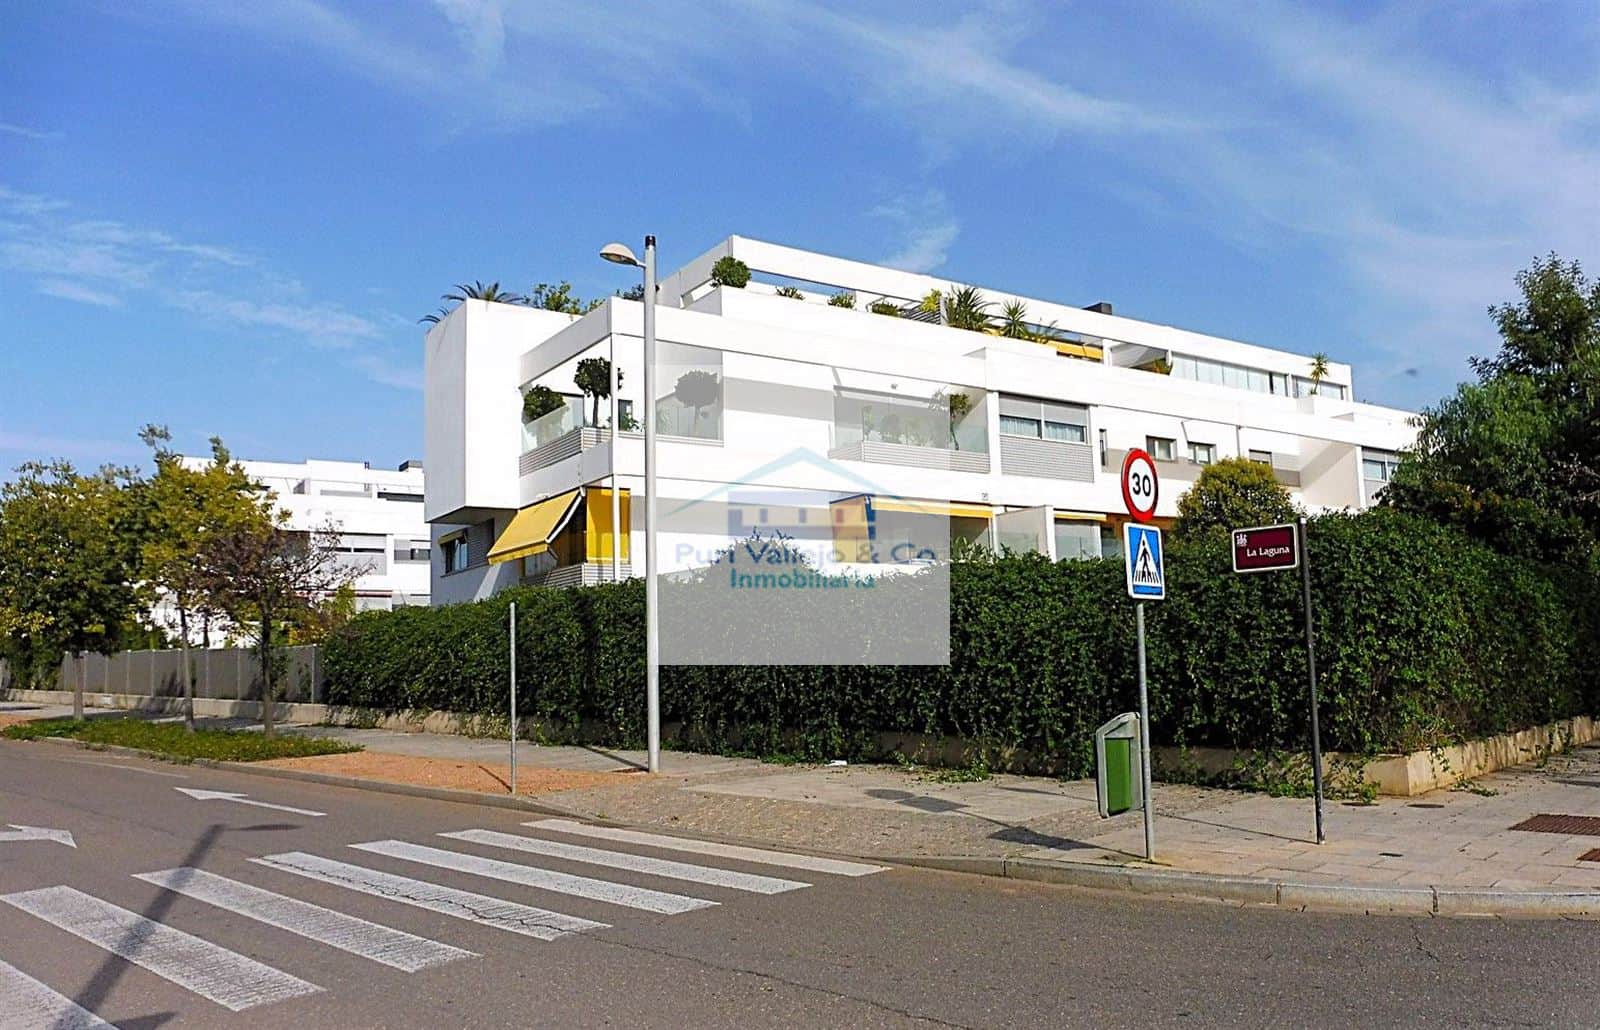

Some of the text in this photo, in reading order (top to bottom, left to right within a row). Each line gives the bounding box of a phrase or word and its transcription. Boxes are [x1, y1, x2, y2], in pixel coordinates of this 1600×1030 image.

[1132, 472, 1151, 497] 30
[1246, 546, 1290, 557] La Laguna
